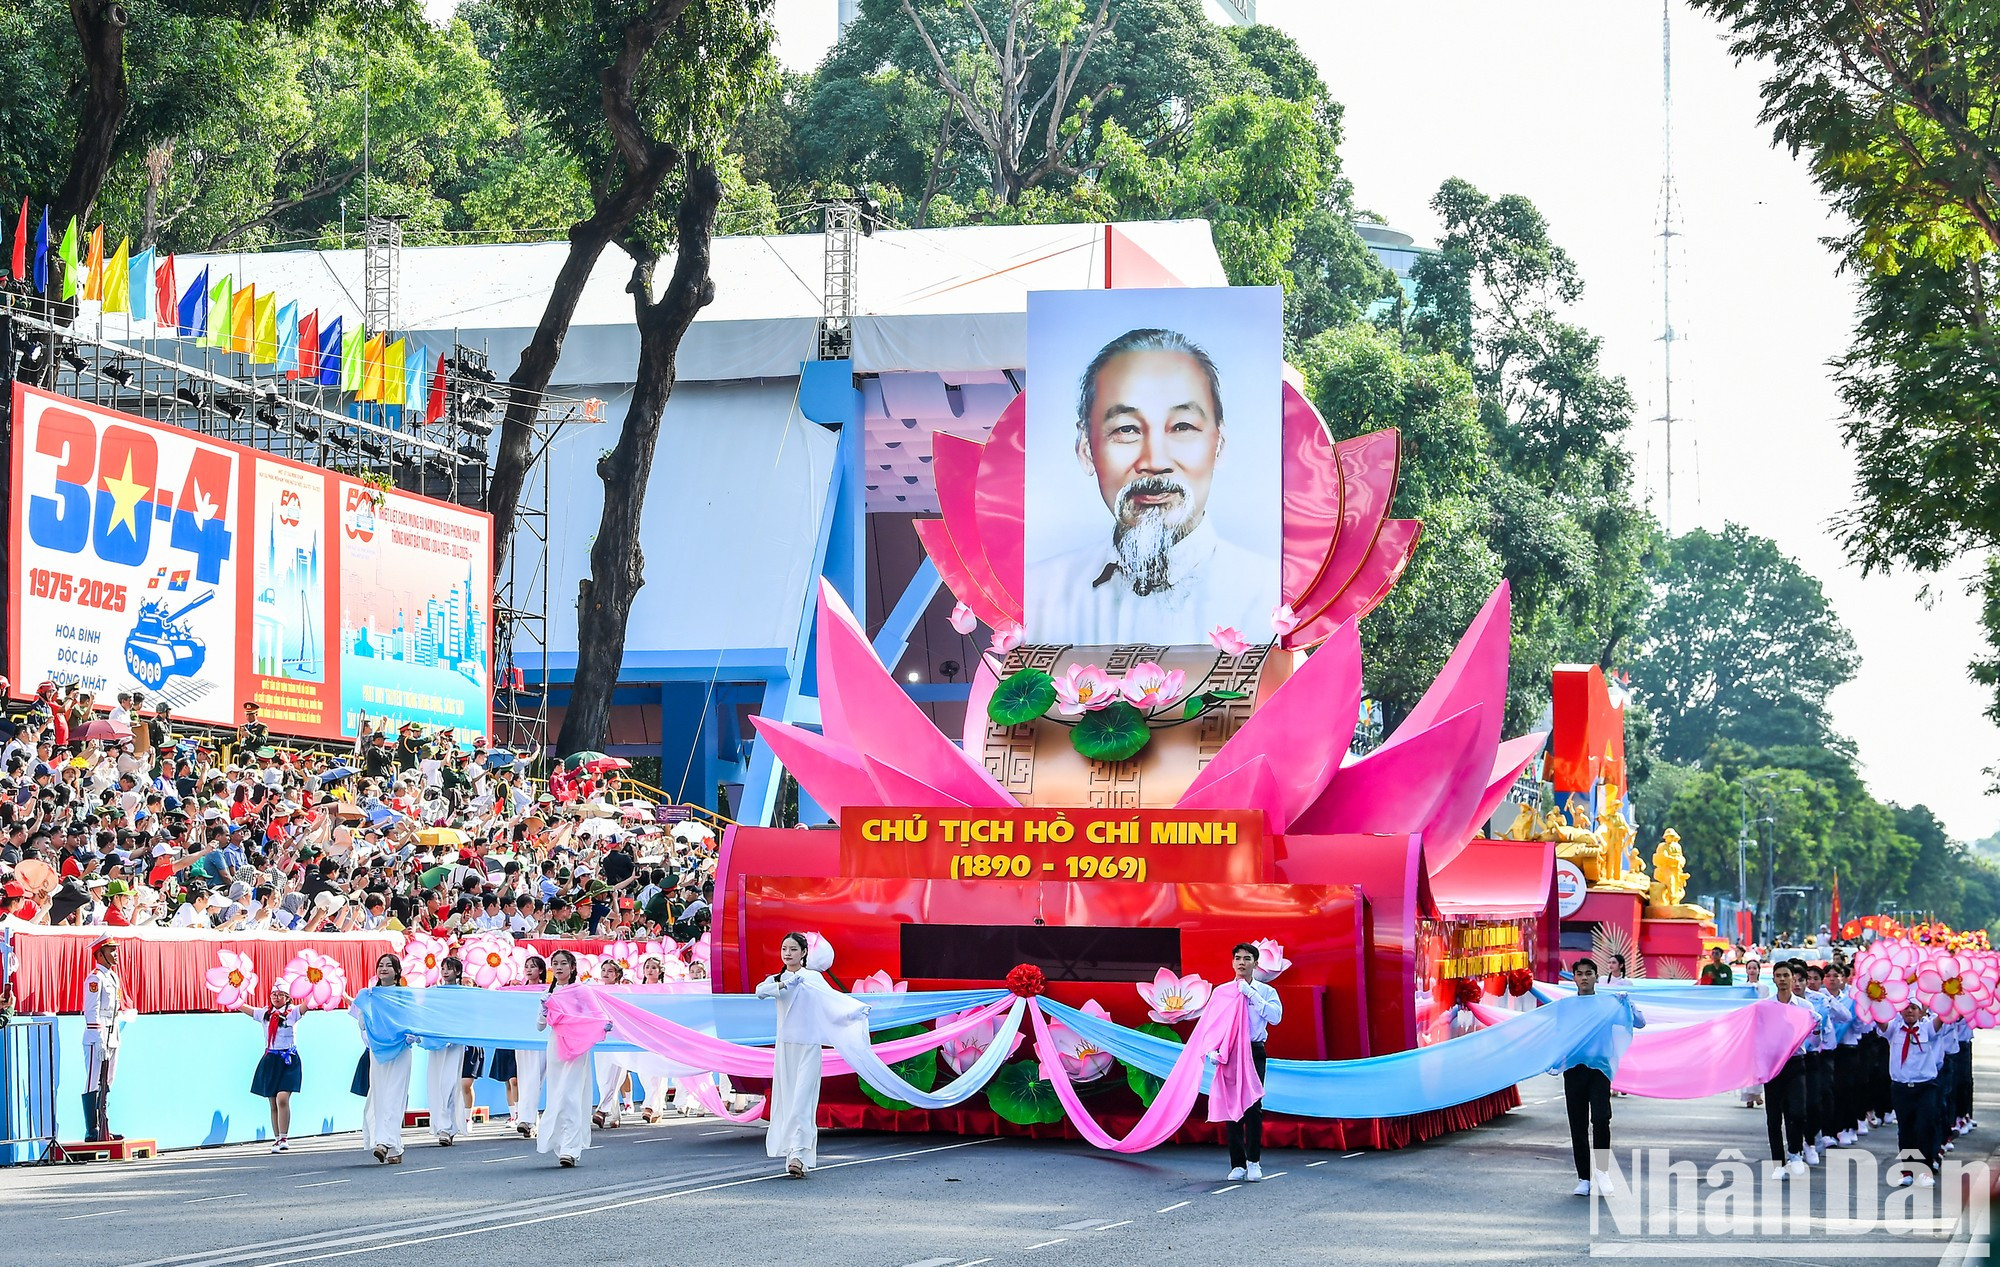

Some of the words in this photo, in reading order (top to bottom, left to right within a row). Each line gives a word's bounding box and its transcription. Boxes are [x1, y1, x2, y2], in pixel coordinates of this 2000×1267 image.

[29, 407, 232, 585] 30-4
[55, 622, 76, 640] HÒA
[78, 626, 101, 644] BÌNH
[57, 646, 78, 665] ĐỘC
[80, 649, 98, 668] LẬP
[81, 674, 107, 693] NHẤT
[861, 813, 928, 843] CHỦ
[939, 819, 1012, 847] TỊCH
[1024, 811, 1075, 844] HỒ
[1085, 815, 1140, 844] CHÍ
[1150, 822, 1237, 844] MINH
[950, 855, 1031, 880] (1890
[1042, 863, 1054, 871] -
[1065, 856, 1147, 882] 1969)
